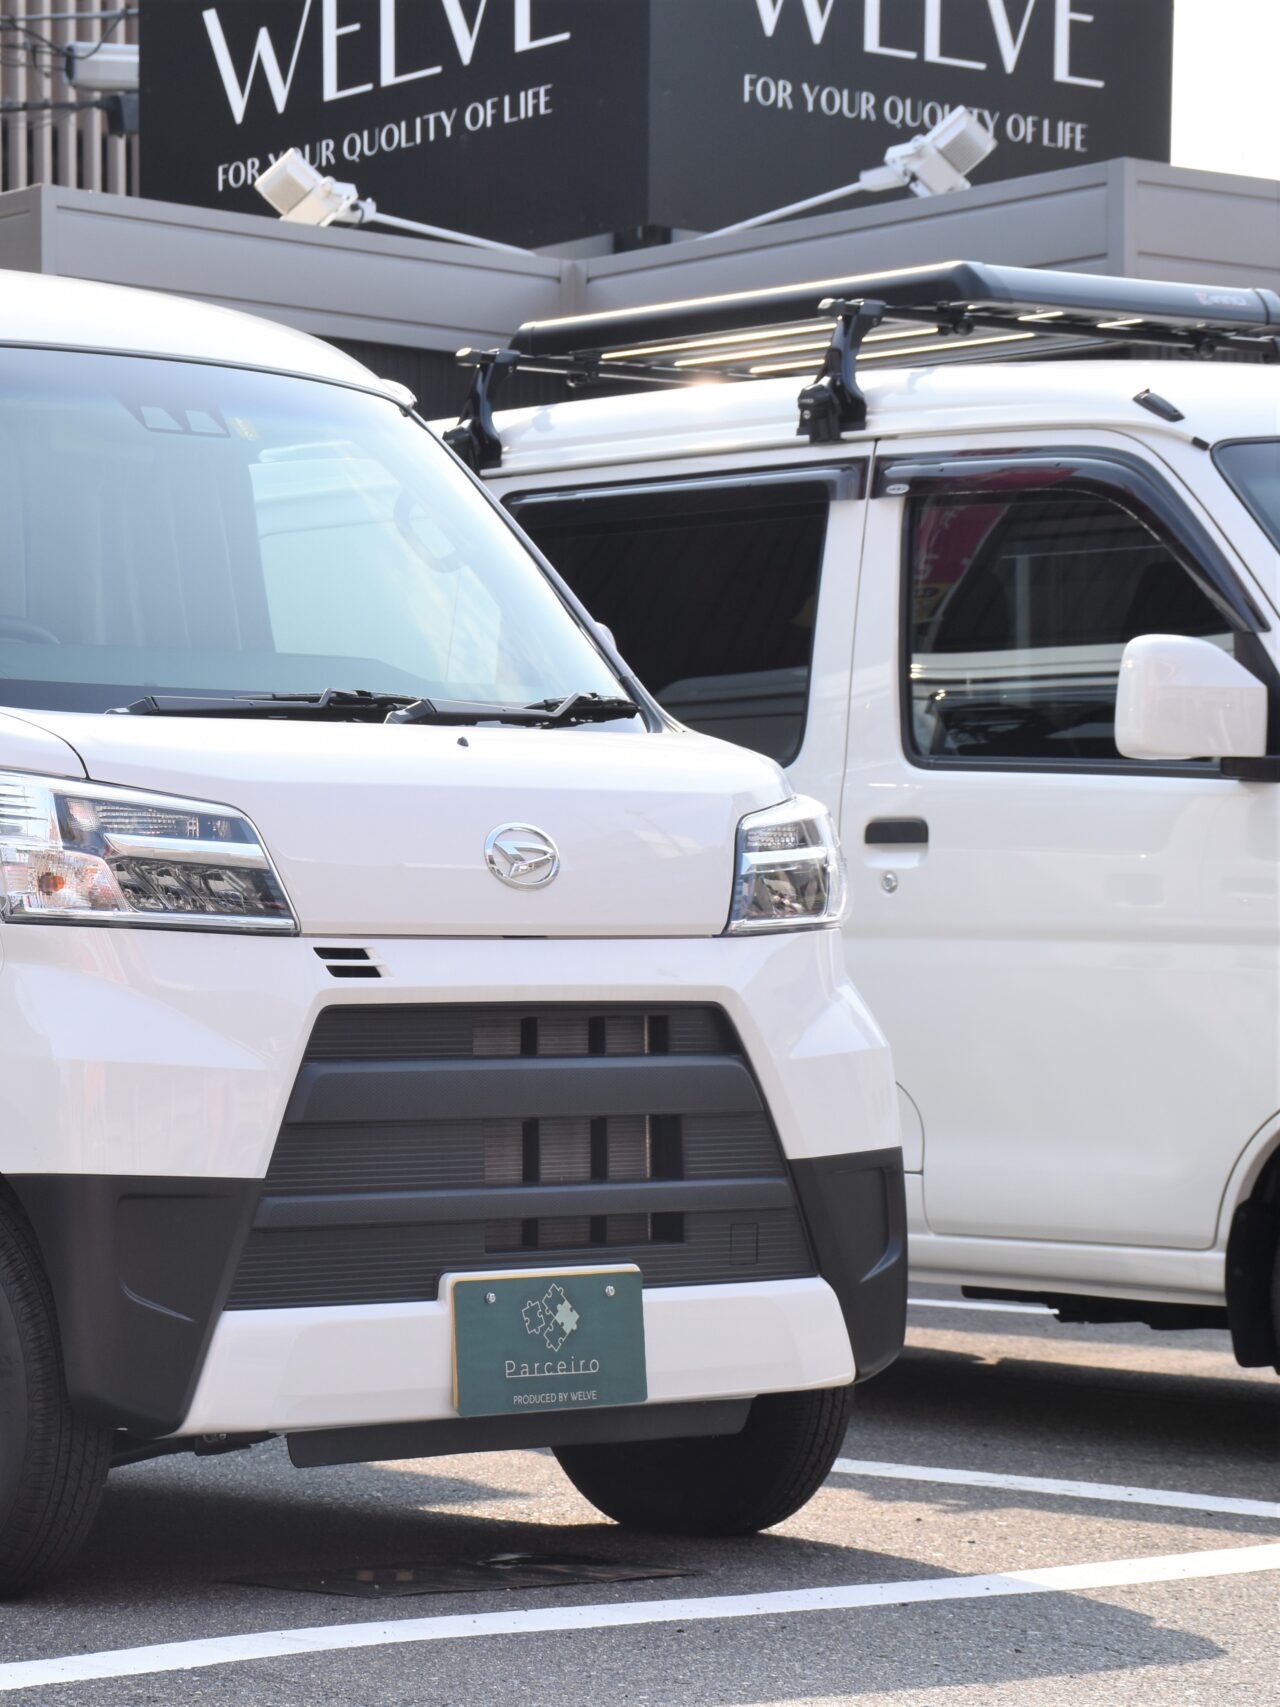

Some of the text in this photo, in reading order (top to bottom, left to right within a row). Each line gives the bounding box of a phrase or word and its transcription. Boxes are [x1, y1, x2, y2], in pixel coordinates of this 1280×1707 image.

[217, 157, 260, 192] FOR
[343, 108, 457, 163] QUOLITY
[464, 97, 499, 131] OF
[504, 84, 553, 124] LIFE
[743, 73, 1088, 152] FOR YOUR QUOTY OF LIFE
[504, 1355, 600, 1378] Parceiro
[513, 1390, 598, 1405] PRODUCED BY WELVE
